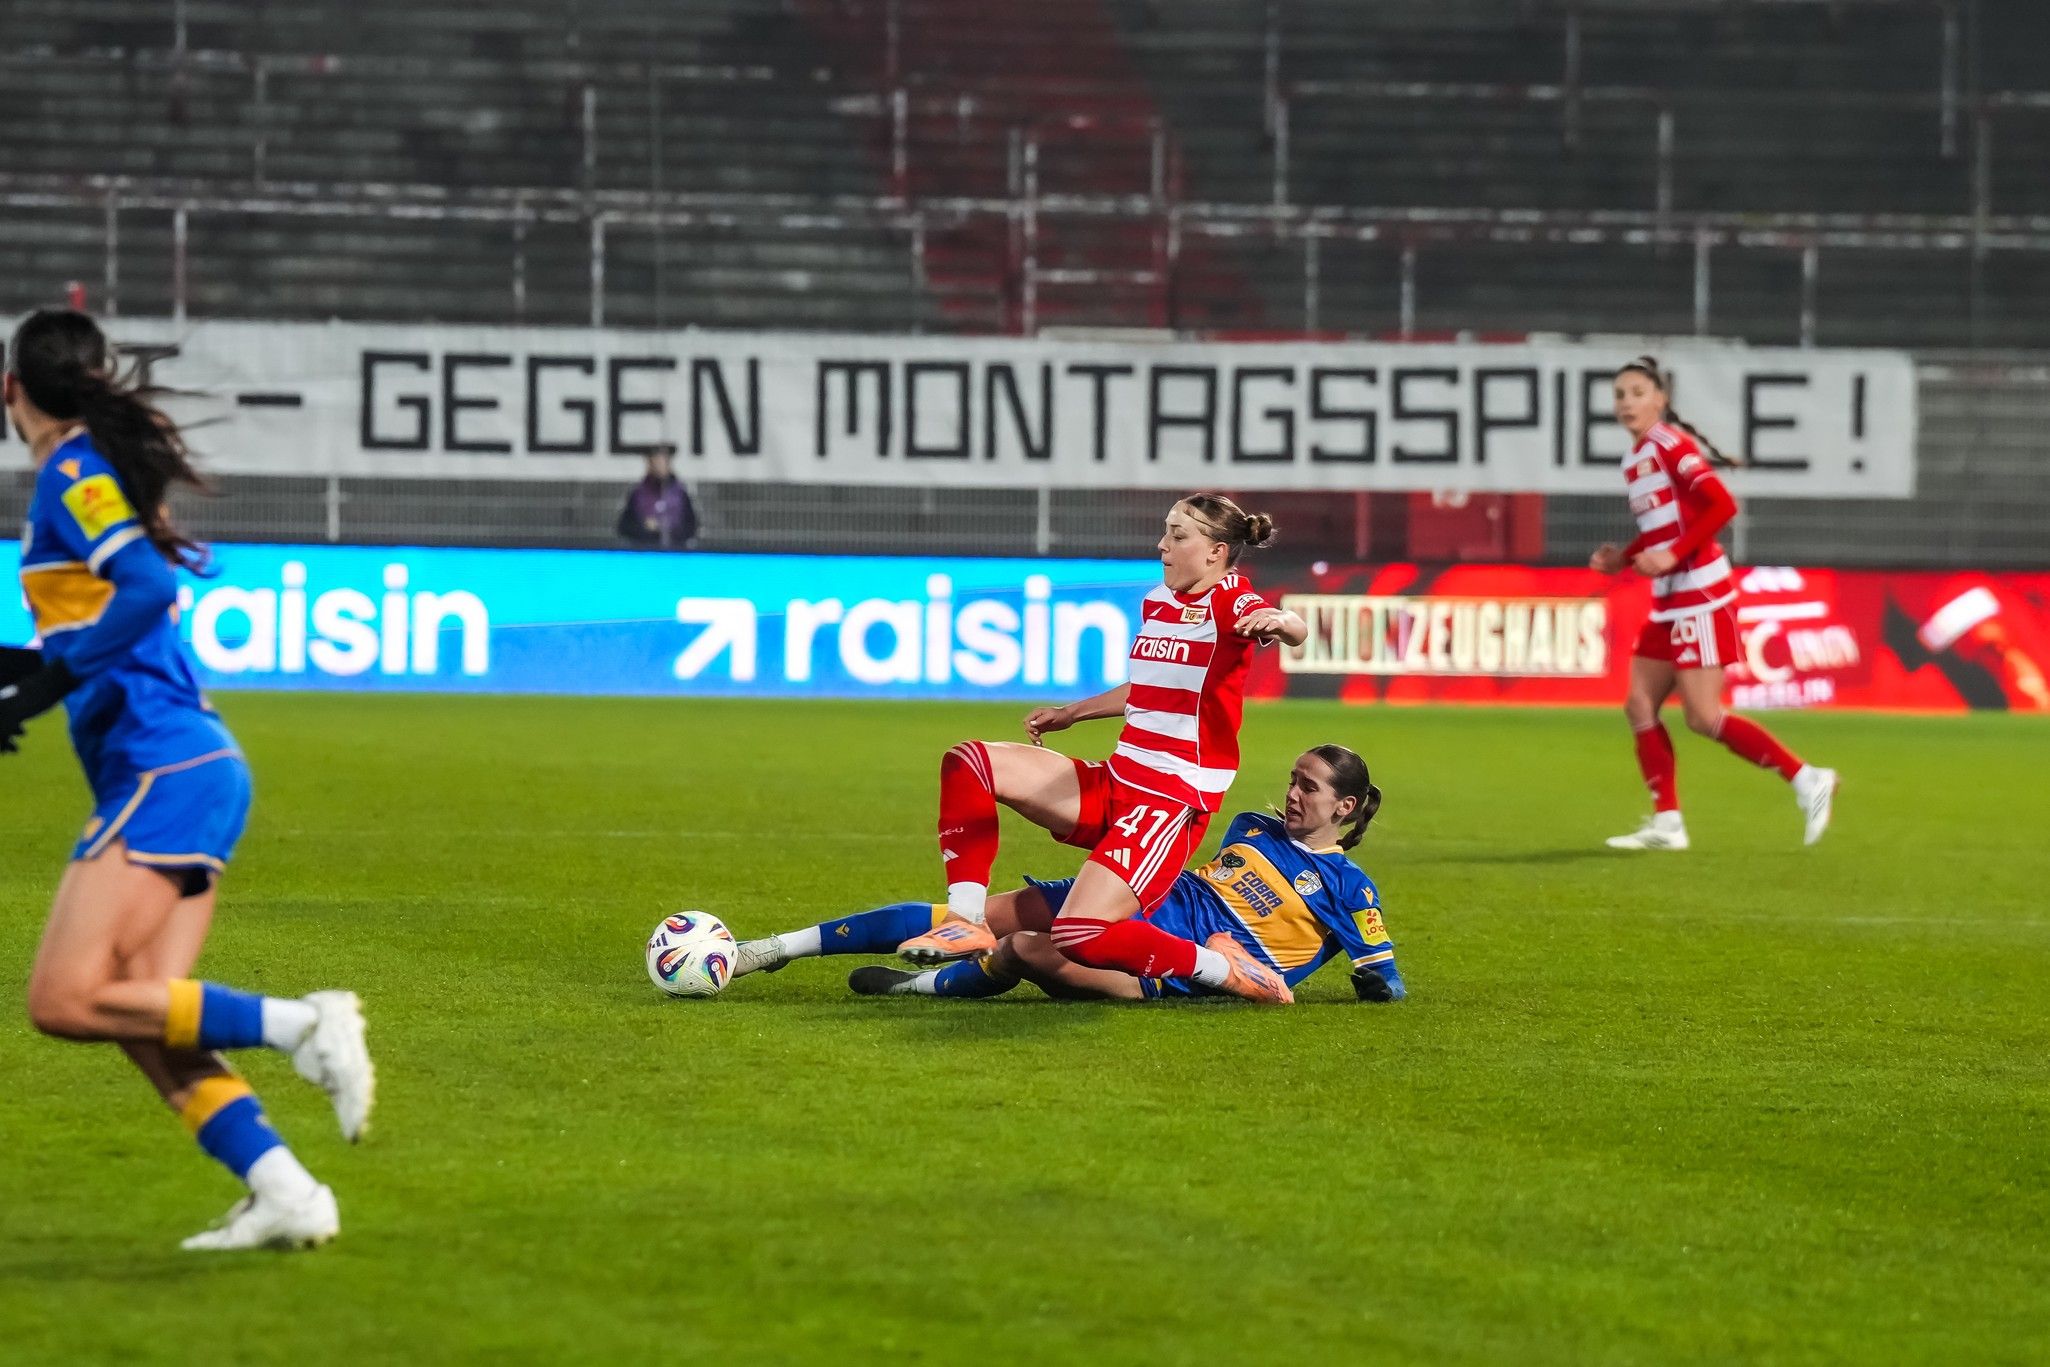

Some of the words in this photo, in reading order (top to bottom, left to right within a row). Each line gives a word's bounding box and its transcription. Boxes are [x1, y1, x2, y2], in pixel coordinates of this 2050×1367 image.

[360, 350, 761, 456] GEGEN
[816, 359, 1867, 473] MONTAGSSPIEE!
[177, 563, 488, 676] aisin
[785, 574, 1129, 686] raisin
[1132, 634, 1190, 662] raisin
[1114, 804, 1170, 849] 41
[1231, 880, 1273, 919] CARDS
[1240, 870, 1284, 909] COBRA
